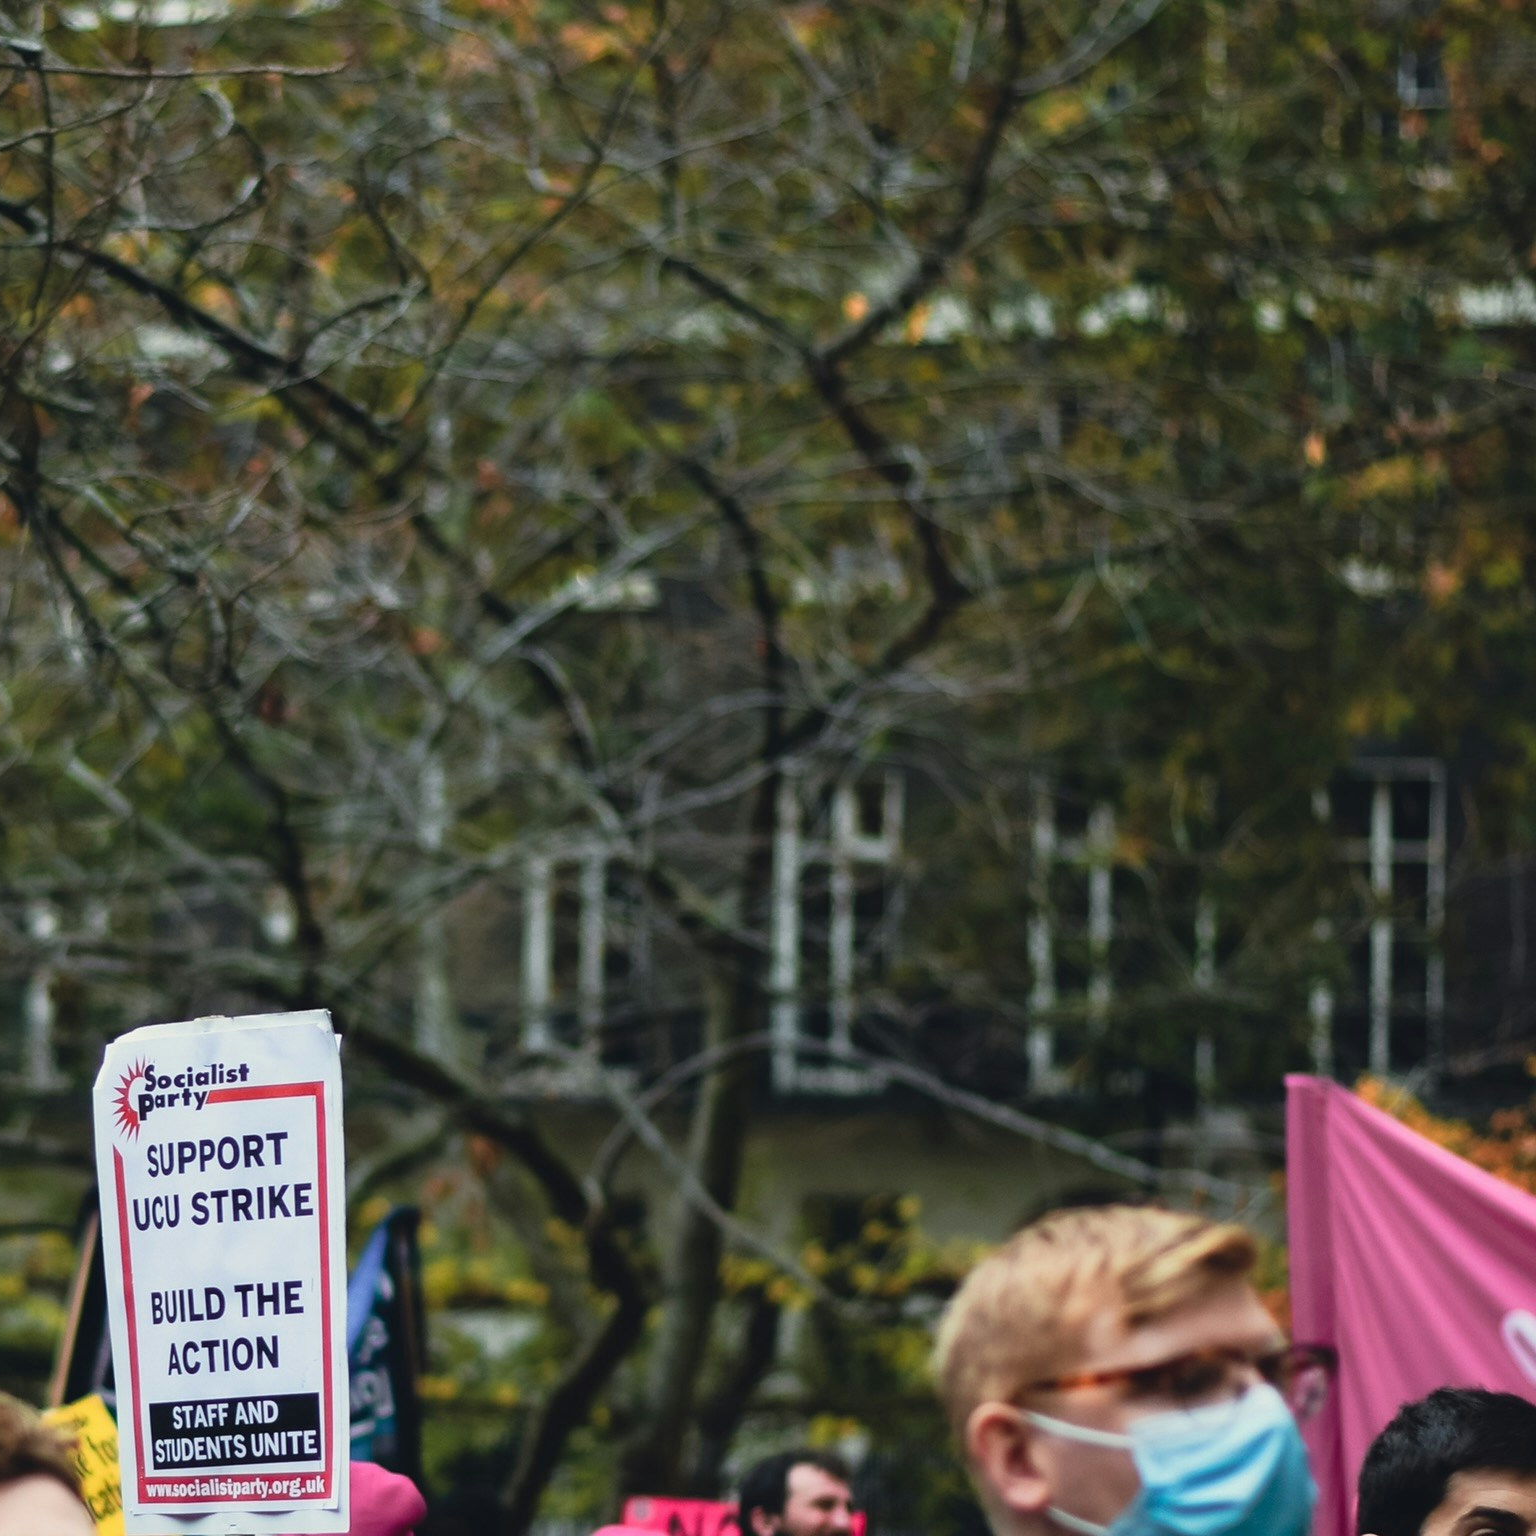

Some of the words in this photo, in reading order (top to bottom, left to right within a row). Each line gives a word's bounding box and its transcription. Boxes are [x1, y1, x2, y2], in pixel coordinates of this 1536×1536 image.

[144, 1063, 249, 1091] Socialist
[147, 1132, 288, 1177] SUPPORT
[133, 1195, 179, 1231] UCU
[192, 1183, 313, 1225] STRIKE
[151, 1287, 225, 1324] BUILD
[234, 1281, 303, 1317] THE
[169, 1336, 278, 1375] ACTION
[173, 1403, 228, 1429] STAFF
[235, 1400, 278, 1425] AND
[156, 1435, 246, 1462] STUDENTS
[251, 1430, 317, 1457] UNITE
